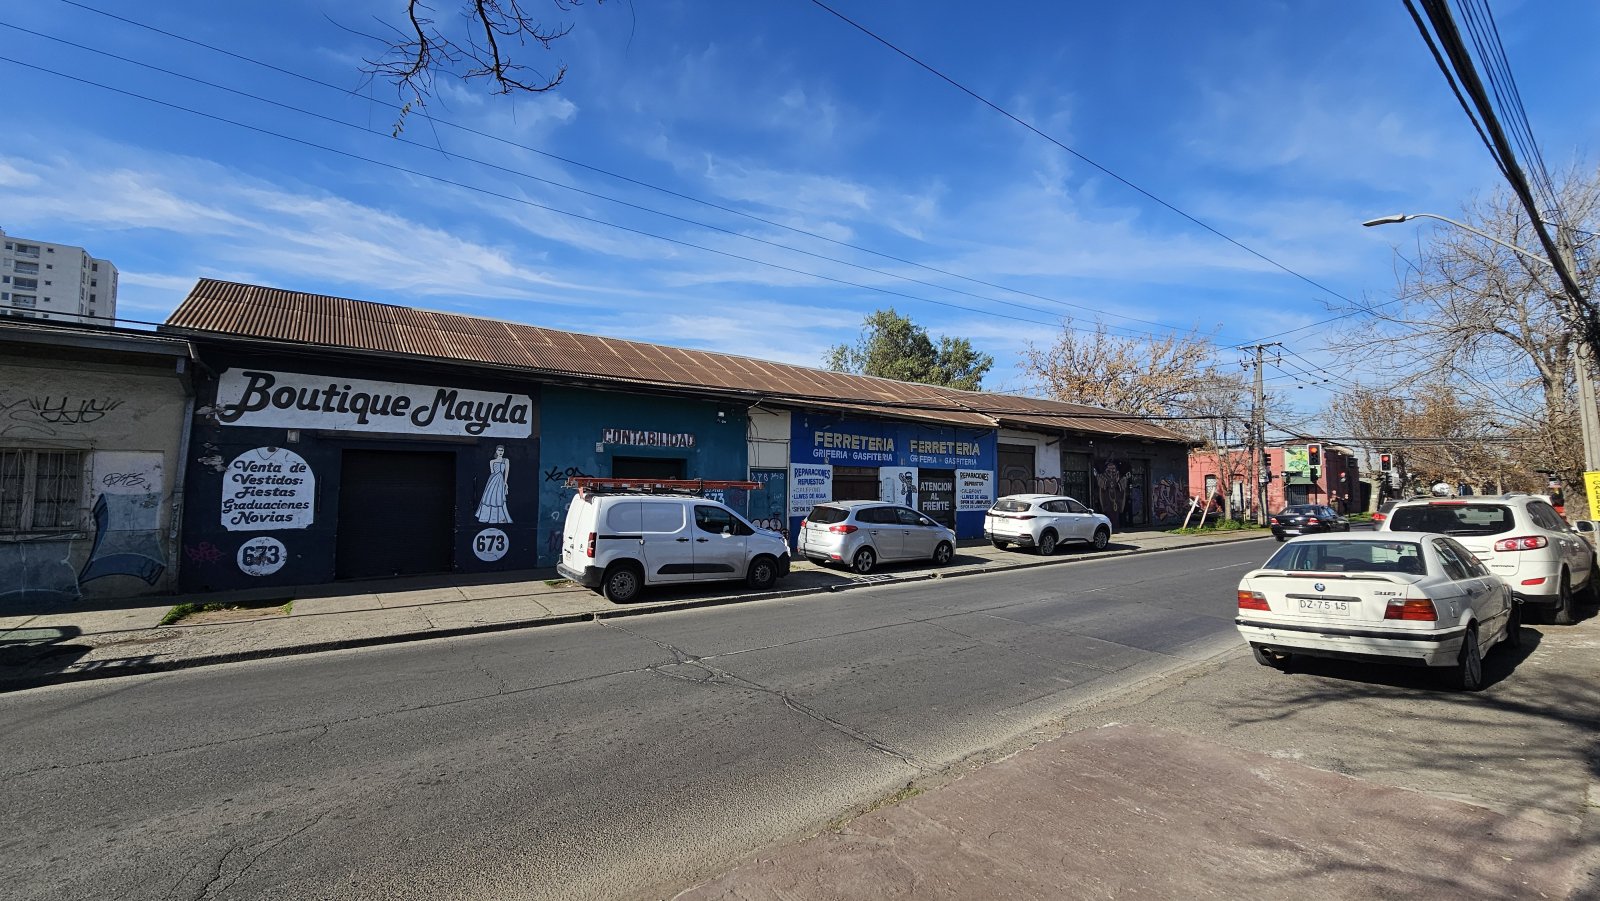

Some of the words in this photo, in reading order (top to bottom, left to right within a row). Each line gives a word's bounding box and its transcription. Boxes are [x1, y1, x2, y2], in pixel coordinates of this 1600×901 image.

[220, 371, 411, 425] Boutique
[410, 388, 528, 435] Mayda
[603, 428, 695, 448] CONTABILIDAD
[814, 431, 895, 452] FERRETERIA
[909, 439, 981, 456] FERRETERIA
[812, 448, 848, 459] GRIFERIA
[852, 451, 893, 462] GASFITERIA
[909, 454, 937, 464] GRFERIA
[944, 457, 977, 466] GASFITERIA
[233, 460, 282, 473] Venta
[289, 462, 307, 473] de
[231, 473, 304, 486] Vestidos:
[794, 468, 831, 480] REPARACIONES
[797, 478, 825, 486] REPUESTOS
[920, 481, 953, 492] ATENCION
[234, 486, 297, 500] Fiestas
[930, 492, 940, 501] AL
[222, 498, 310, 515] Graduaciones
[922, 501, 950, 511] FRENTE
[230, 511, 294, 525] Novias
[476, 534, 505, 553] 673
[242, 545, 280, 567] 673
